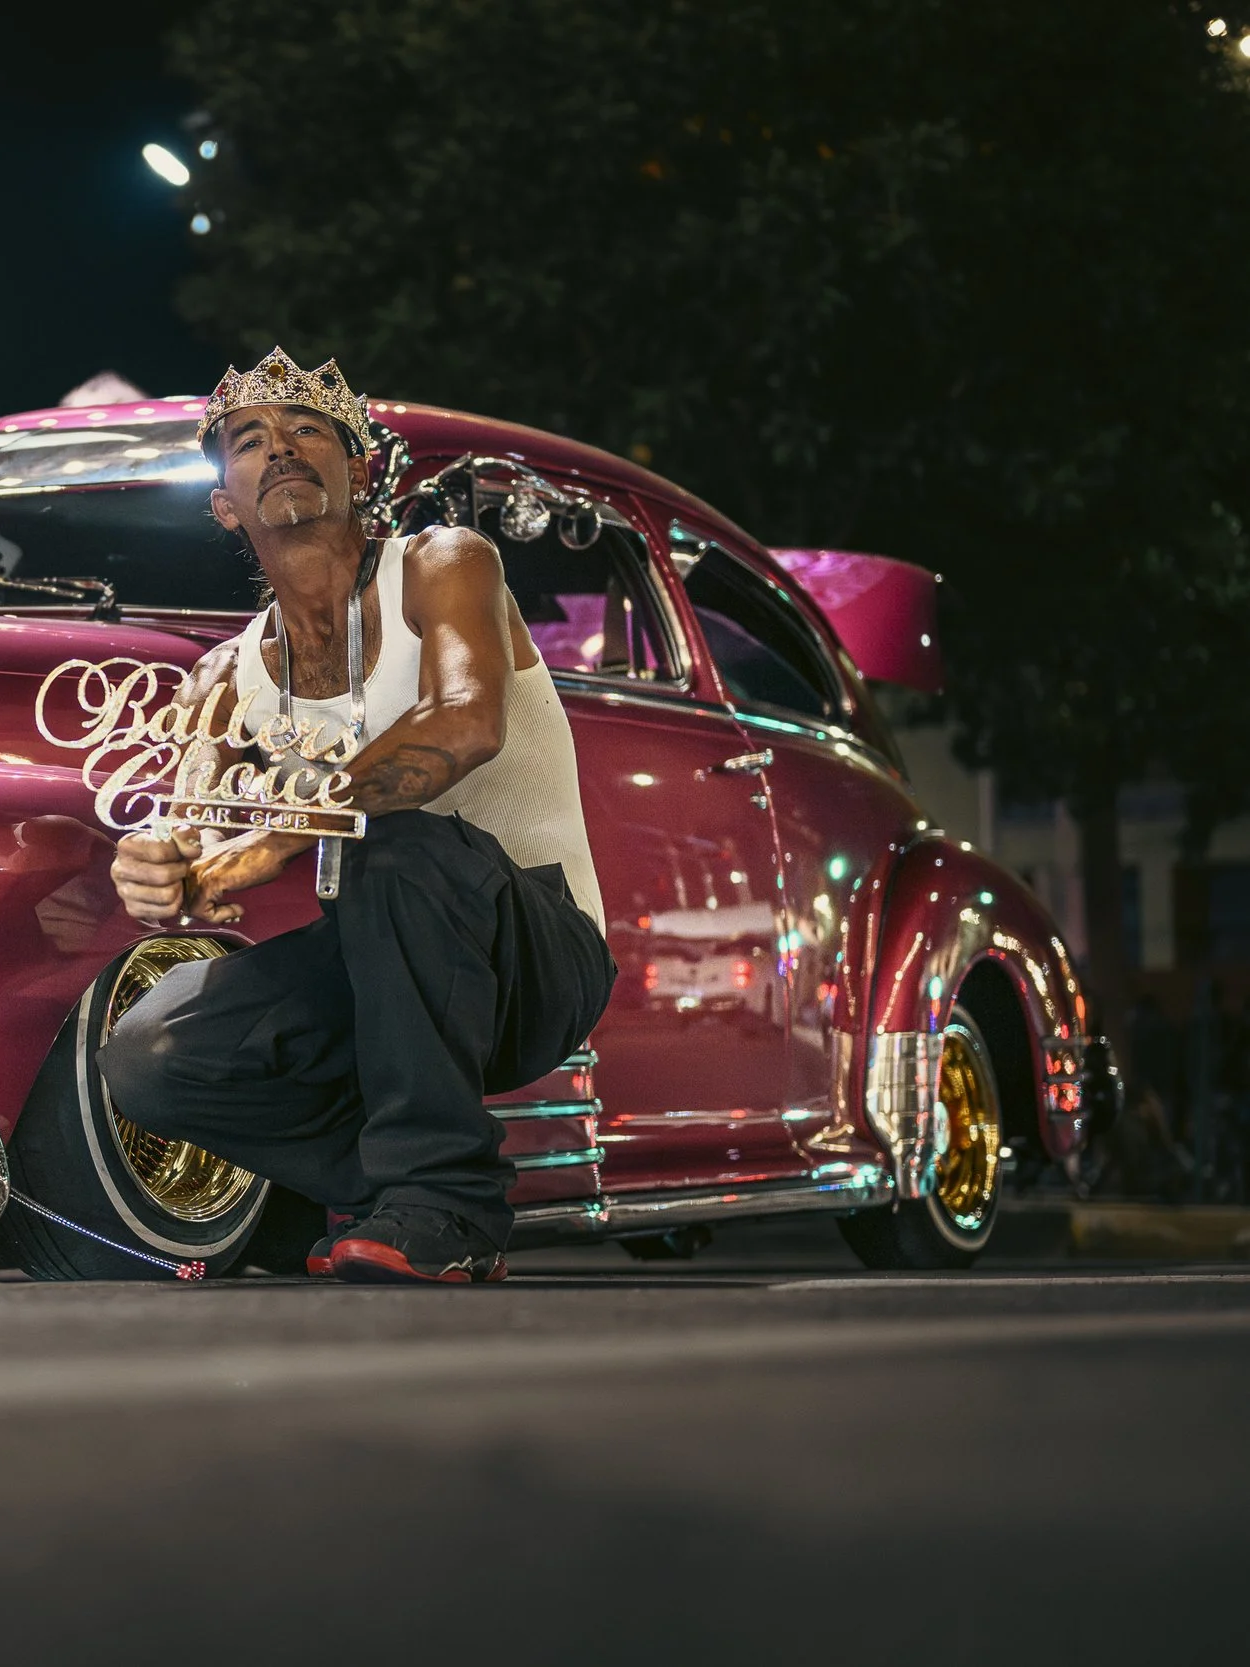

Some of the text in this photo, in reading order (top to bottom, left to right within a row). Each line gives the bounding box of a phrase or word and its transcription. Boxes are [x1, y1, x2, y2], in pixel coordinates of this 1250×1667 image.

[35, 657, 359, 764] Ballers
[82, 742, 354, 829] Choice
[185, 804, 311, 830] CAR CLUB
